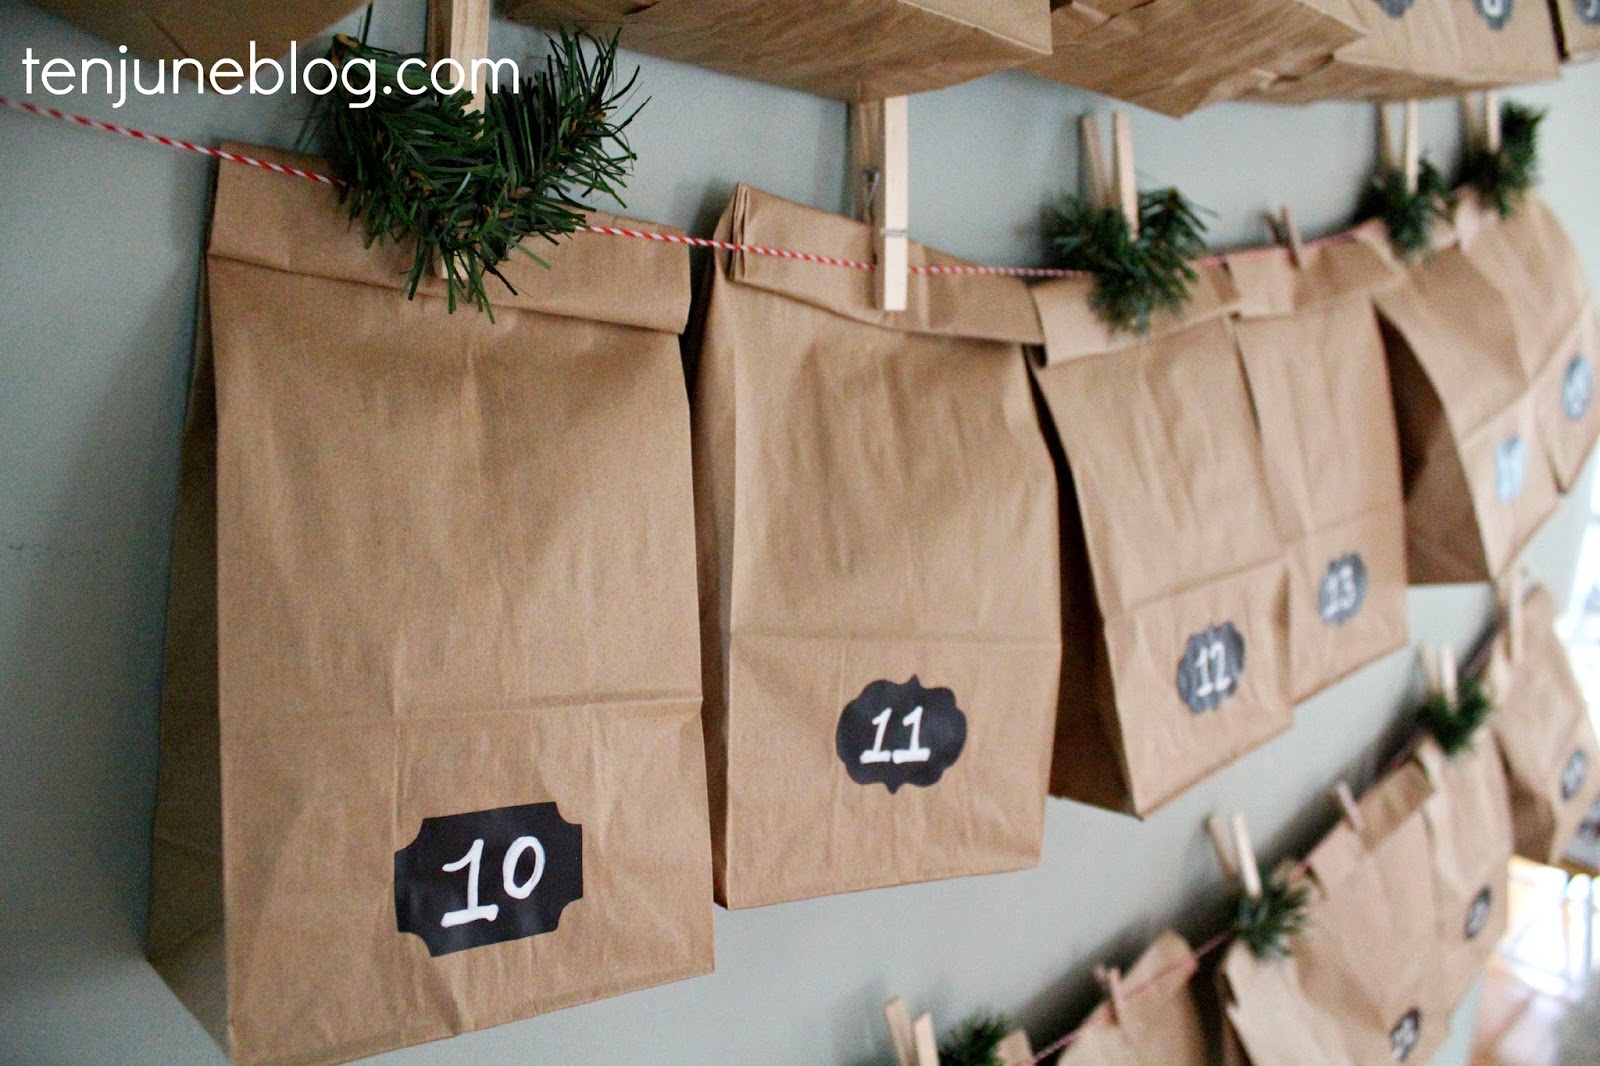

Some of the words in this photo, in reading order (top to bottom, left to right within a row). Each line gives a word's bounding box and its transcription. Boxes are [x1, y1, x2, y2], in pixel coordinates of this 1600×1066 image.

[1323, 565, 1357, 617] 13
[1195, 641, 1232, 697] 12
[860, 705, 931, 764] 11
[440, 836, 545, 928] 10
